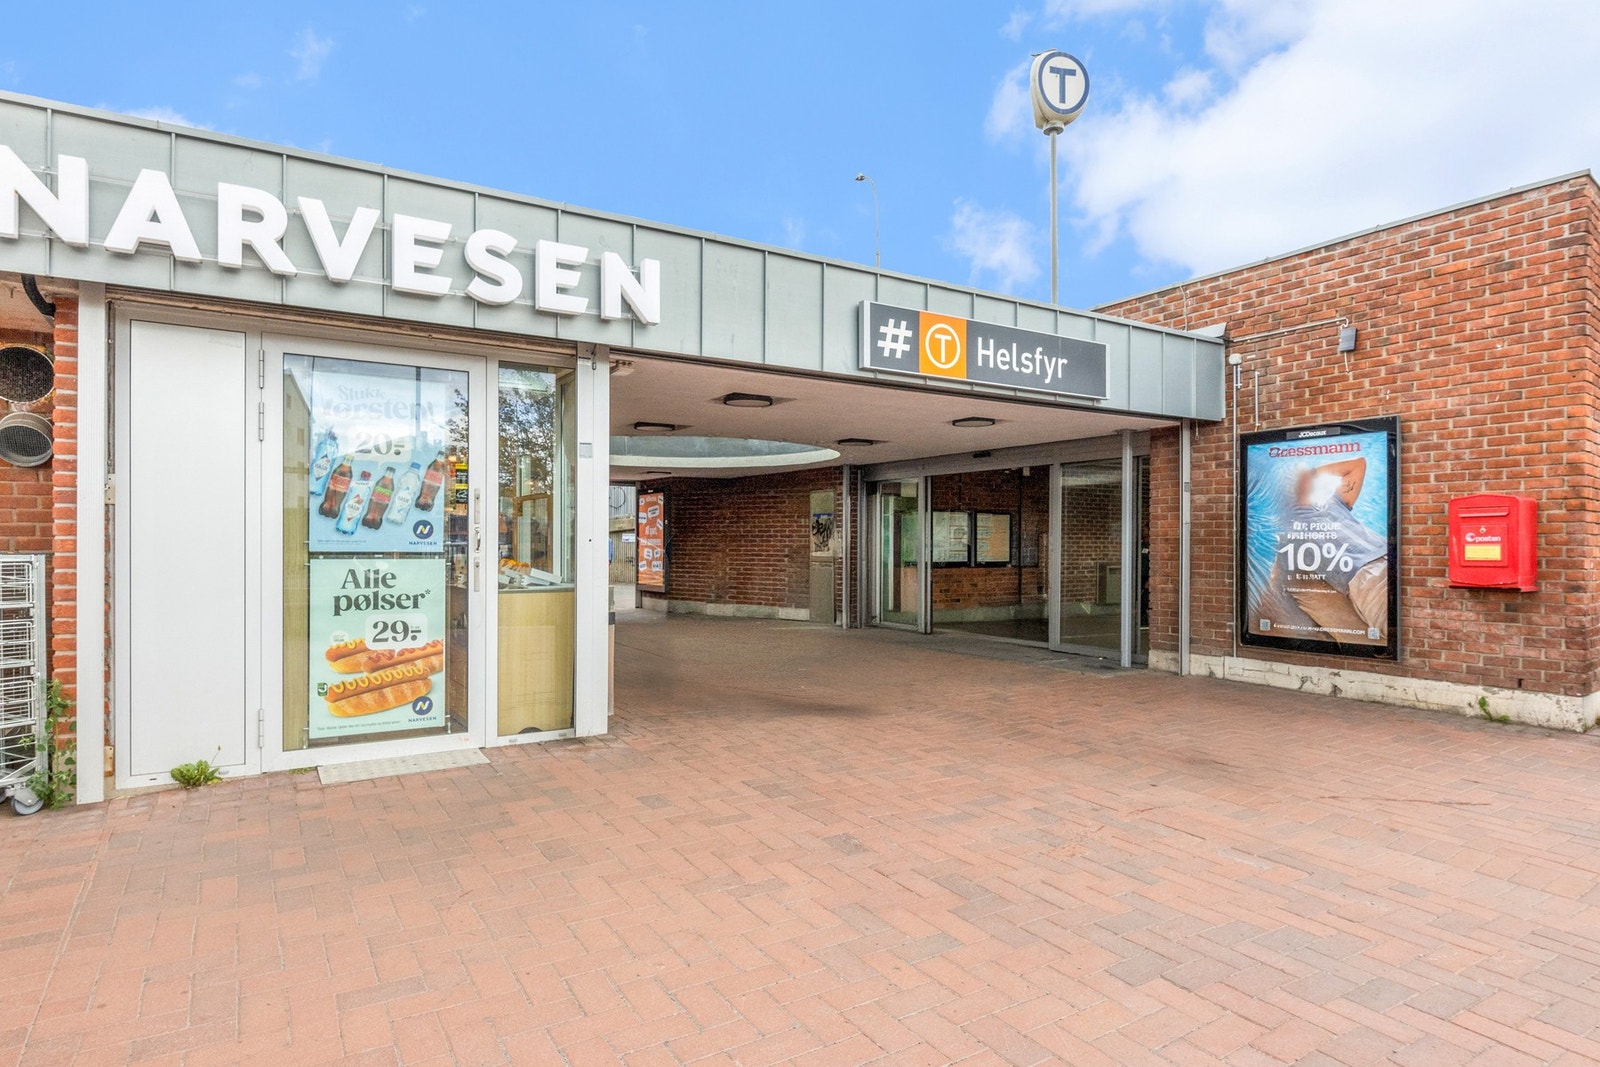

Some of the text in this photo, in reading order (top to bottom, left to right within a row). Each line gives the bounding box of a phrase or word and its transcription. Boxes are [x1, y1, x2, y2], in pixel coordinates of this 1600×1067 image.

[1049, 65, 1077, 104] T
[0, 144, 661, 327] NARVESEN
[977, 336, 1068, 383] Helsfyr
[1278, 542, 1353, 572] 10%
[341, 568, 397, 589] Alle
